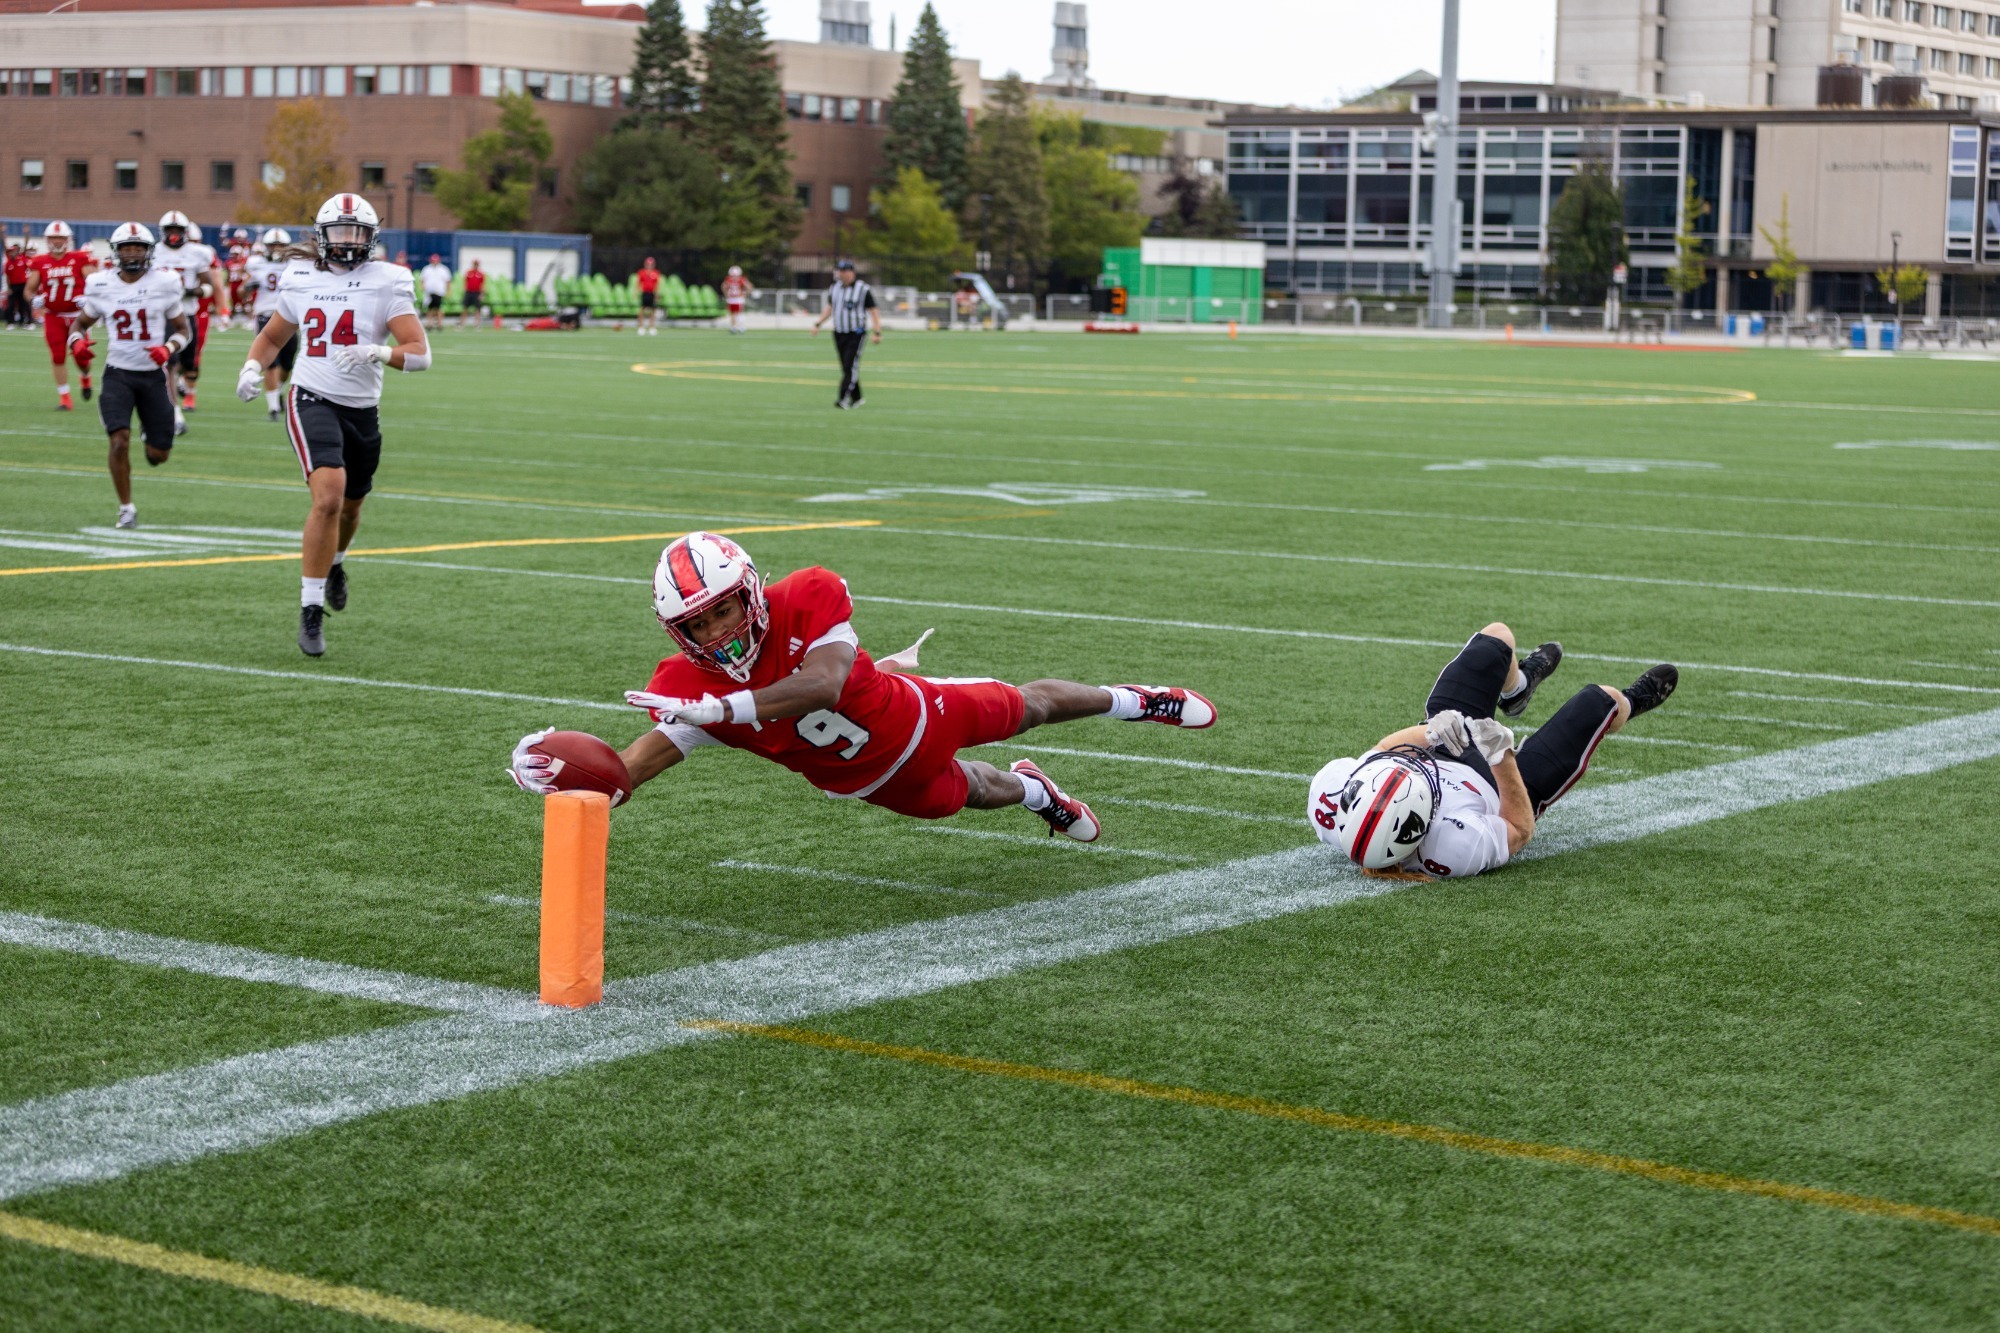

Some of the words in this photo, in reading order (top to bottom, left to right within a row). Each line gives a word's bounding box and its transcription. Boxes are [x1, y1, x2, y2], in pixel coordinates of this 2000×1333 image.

[46, 277, 76, 302] 77
[313, 294, 349, 302] RAVENS
[113, 308, 151, 341] 21
[303, 308, 359, 357] 24
[683, 589, 711, 608] Riddell
[795, 706, 870, 761] 9
